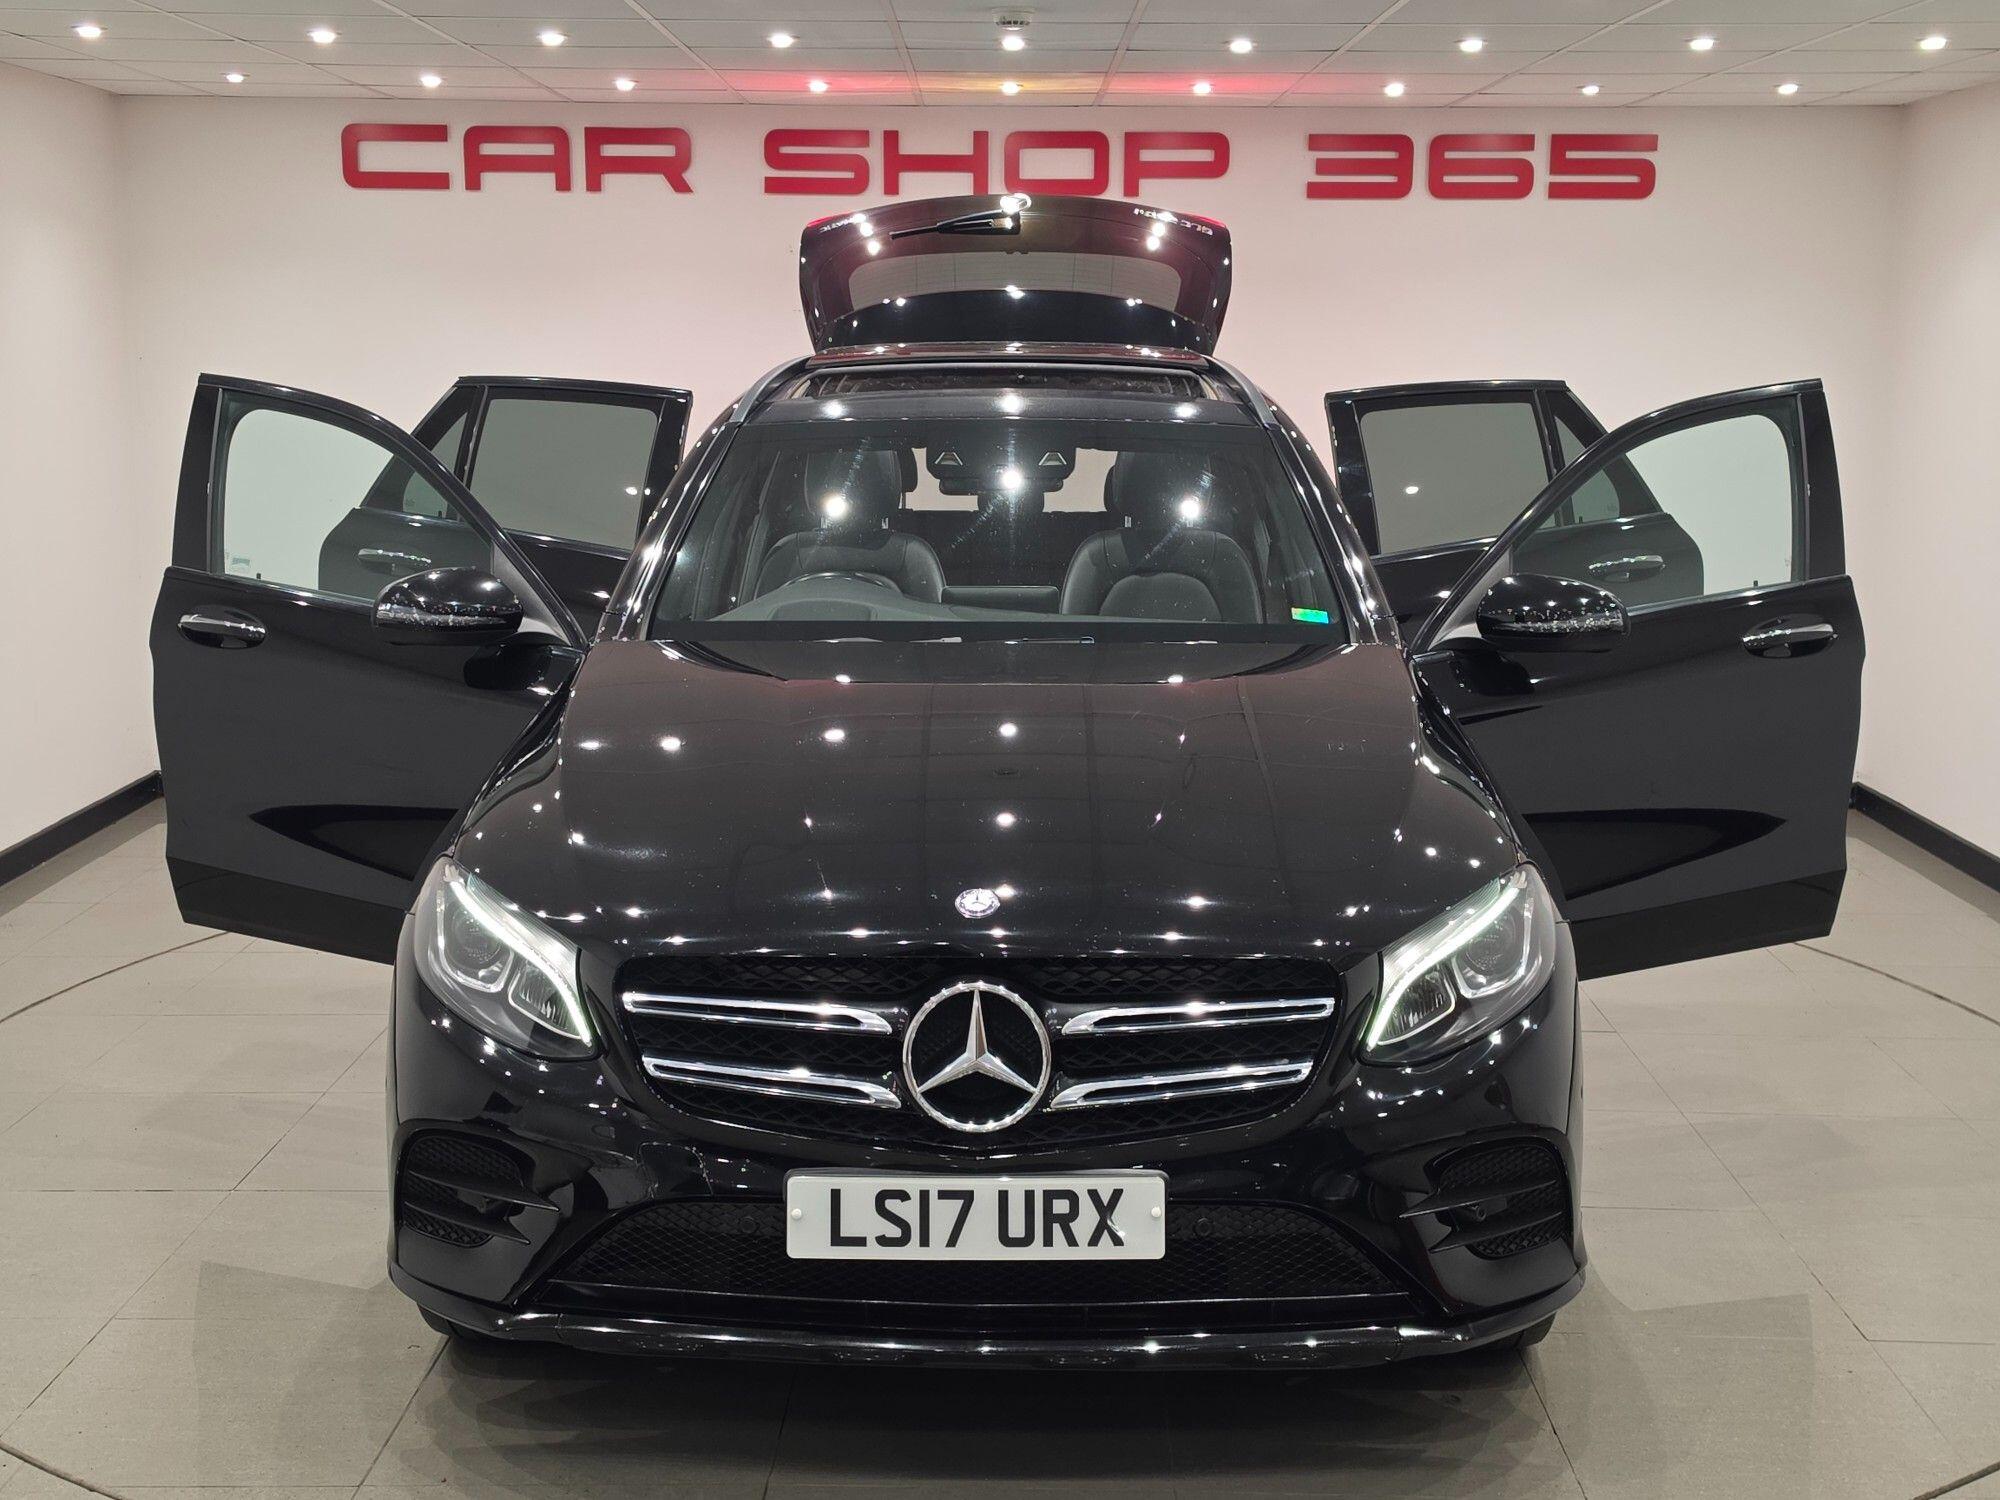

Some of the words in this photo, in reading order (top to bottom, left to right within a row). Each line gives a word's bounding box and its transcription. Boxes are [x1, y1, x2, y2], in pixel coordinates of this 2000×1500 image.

[342, 124, 692, 194] CAR
[763, 128, 1231, 198] SHOP
[1305, 133, 1658, 200] 365
[830, 1188, 975, 1248] LS17
[997, 1188, 1124, 1248] URX
